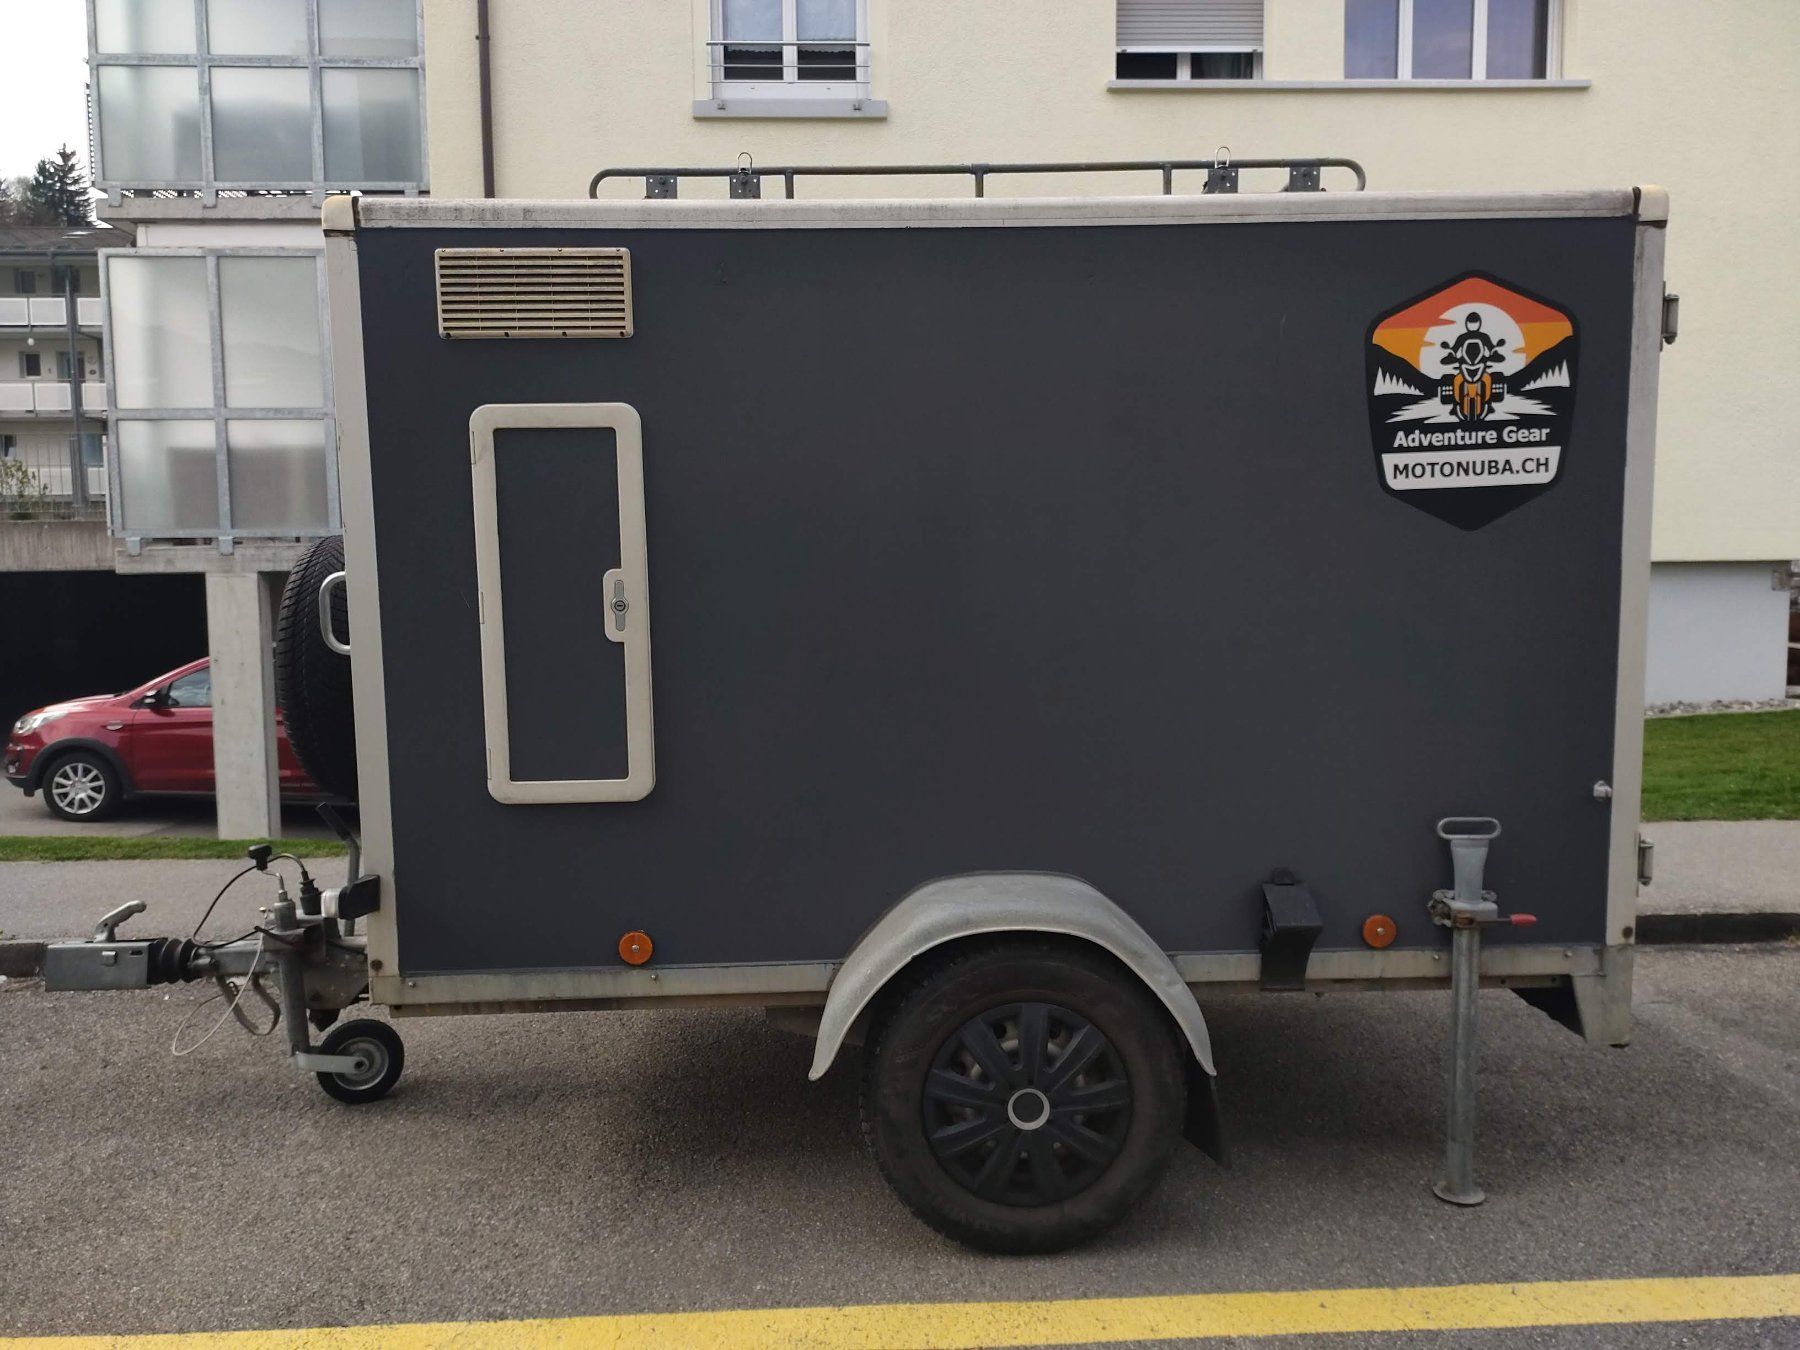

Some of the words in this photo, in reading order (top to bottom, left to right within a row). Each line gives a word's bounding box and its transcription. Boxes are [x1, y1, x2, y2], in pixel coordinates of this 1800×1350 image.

[1393, 428, 1498, 448] Adventure
[1502, 425, 1550, 444] Gear
[1392, 457, 1550, 480] MOTONUBA.CH
